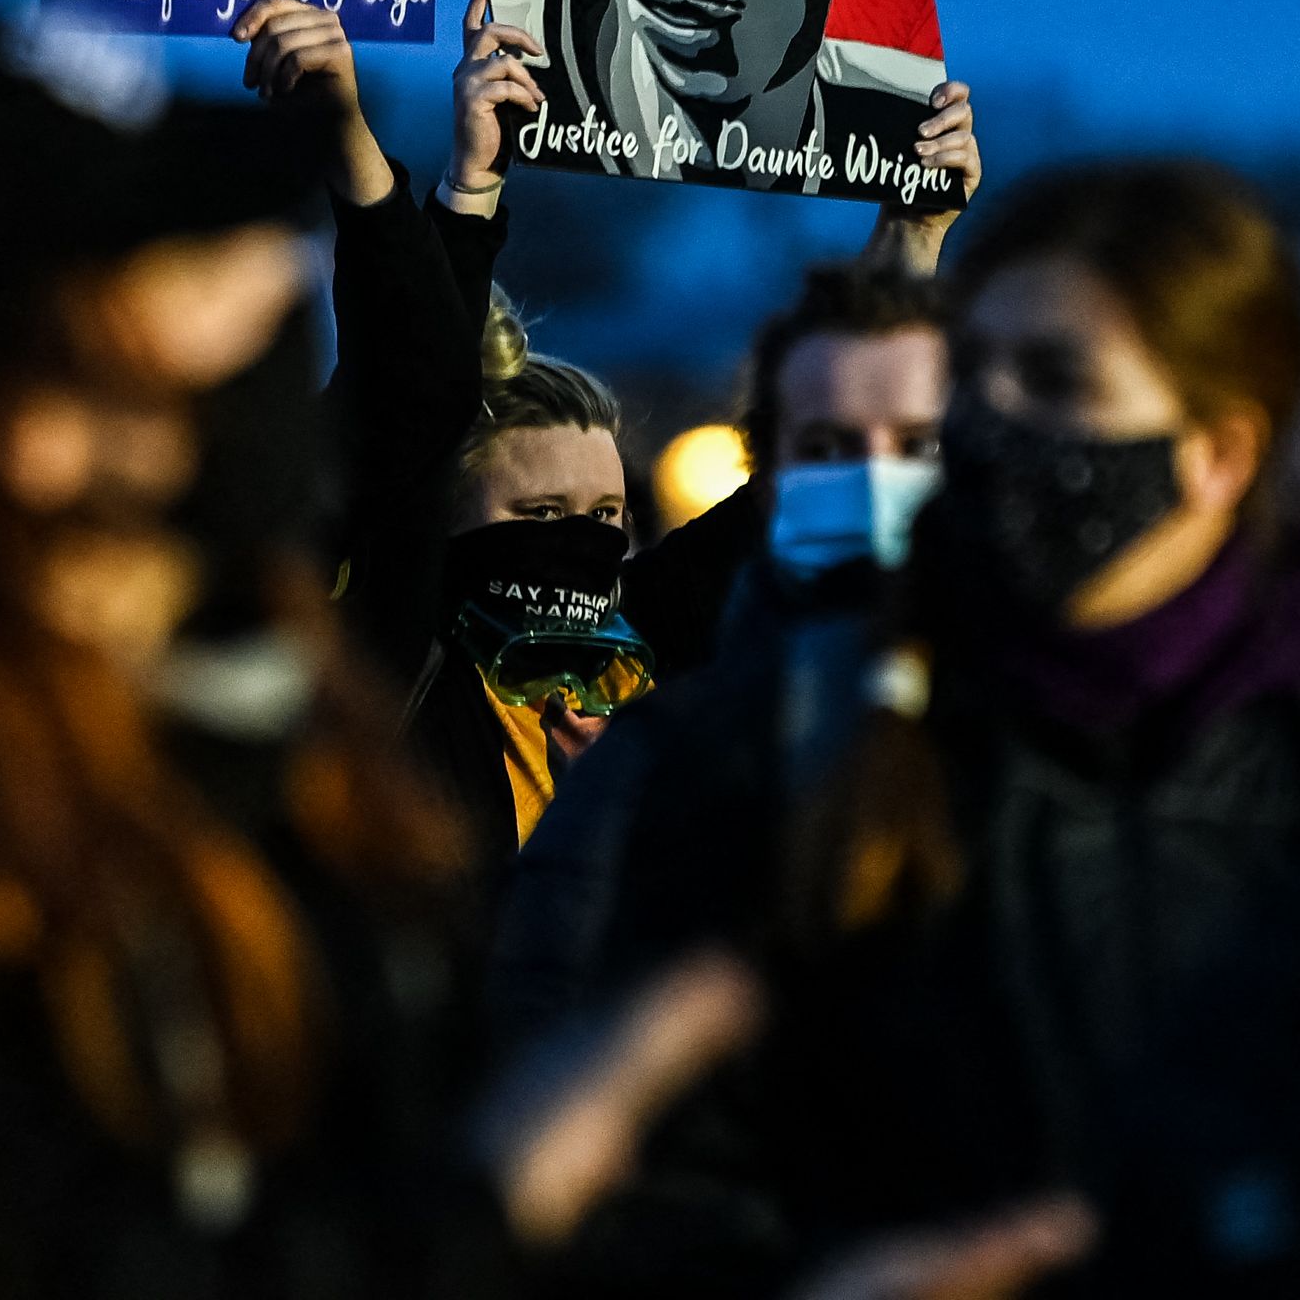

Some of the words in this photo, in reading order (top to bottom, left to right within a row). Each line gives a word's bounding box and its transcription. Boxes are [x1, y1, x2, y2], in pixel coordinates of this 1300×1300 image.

[519, 100, 639, 159] Justice
[652, 114, 703, 180] for
[716, 118, 834, 180] Daunte
[488, 579, 543, 602] SAY
[554, 587, 610, 613] THEIR
[525, 604, 600, 626] NAMES
